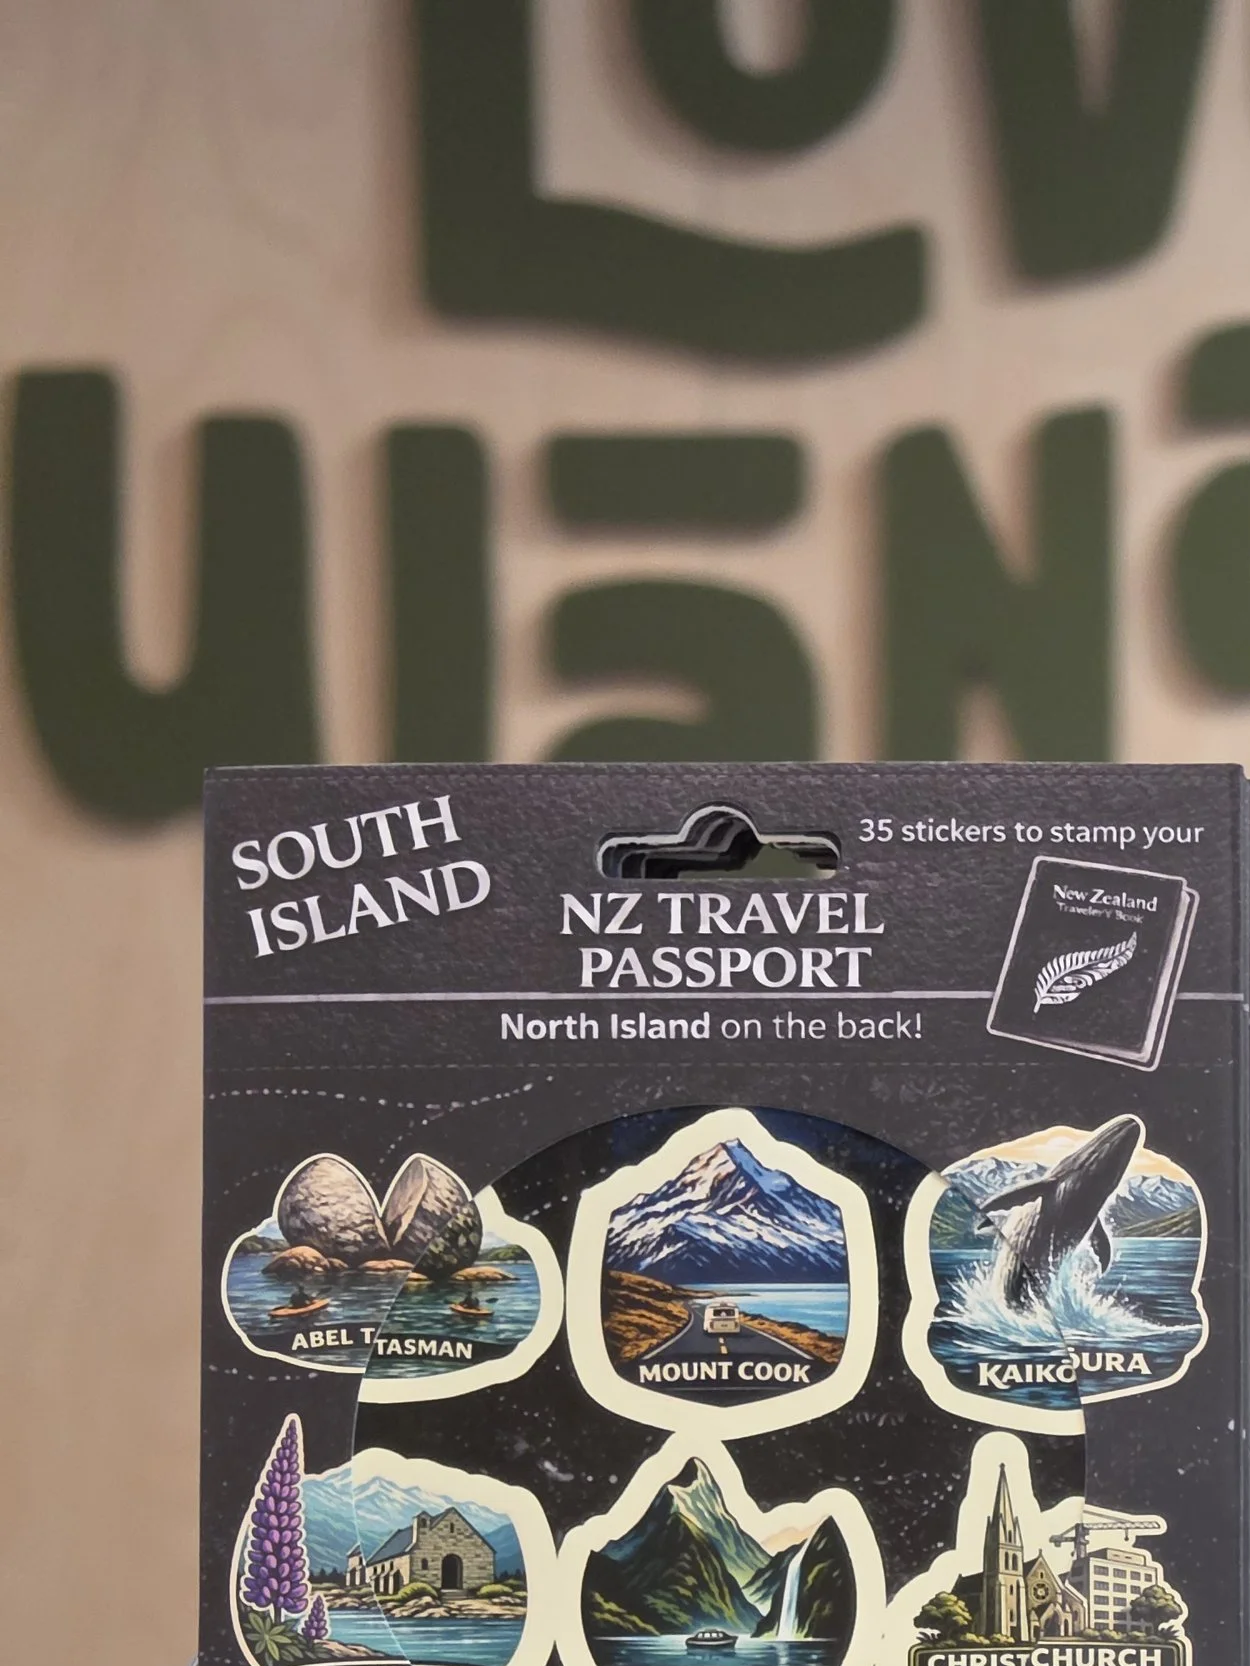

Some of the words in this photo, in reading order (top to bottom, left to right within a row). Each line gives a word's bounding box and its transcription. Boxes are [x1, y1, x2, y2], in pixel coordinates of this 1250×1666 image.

[231, 795, 460, 890] SOUTH
[859, 819, 893, 843] 35
[901, 818, 1006, 843] stickers
[1014, 822, 1043, 843] to
[1050, 822, 1135, 849] stamp
[1143, 825, 1203, 849] your
[247, 859, 491, 958] ISLAND
[560, 893, 642, 935] NZ
[657, 892, 884, 935] TRAVEL
[1053, 884, 1088, 901] New
[1089, 888, 1158, 912] Zealand
[579, 946, 872, 988] PASSPORT
[501, 1012, 598, 1039] North
[610, 1012, 710, 1039] Island
[721, 1018, 761, 1039] on
[774, 1011, 826, 1039] the
[838, 1011, 922, 1039] back!
[291, 1328, 353, 1351] ABEL
[639, 1361, 730, 1384] MOUNT
[738, 1361, 811, 1384] COOK
